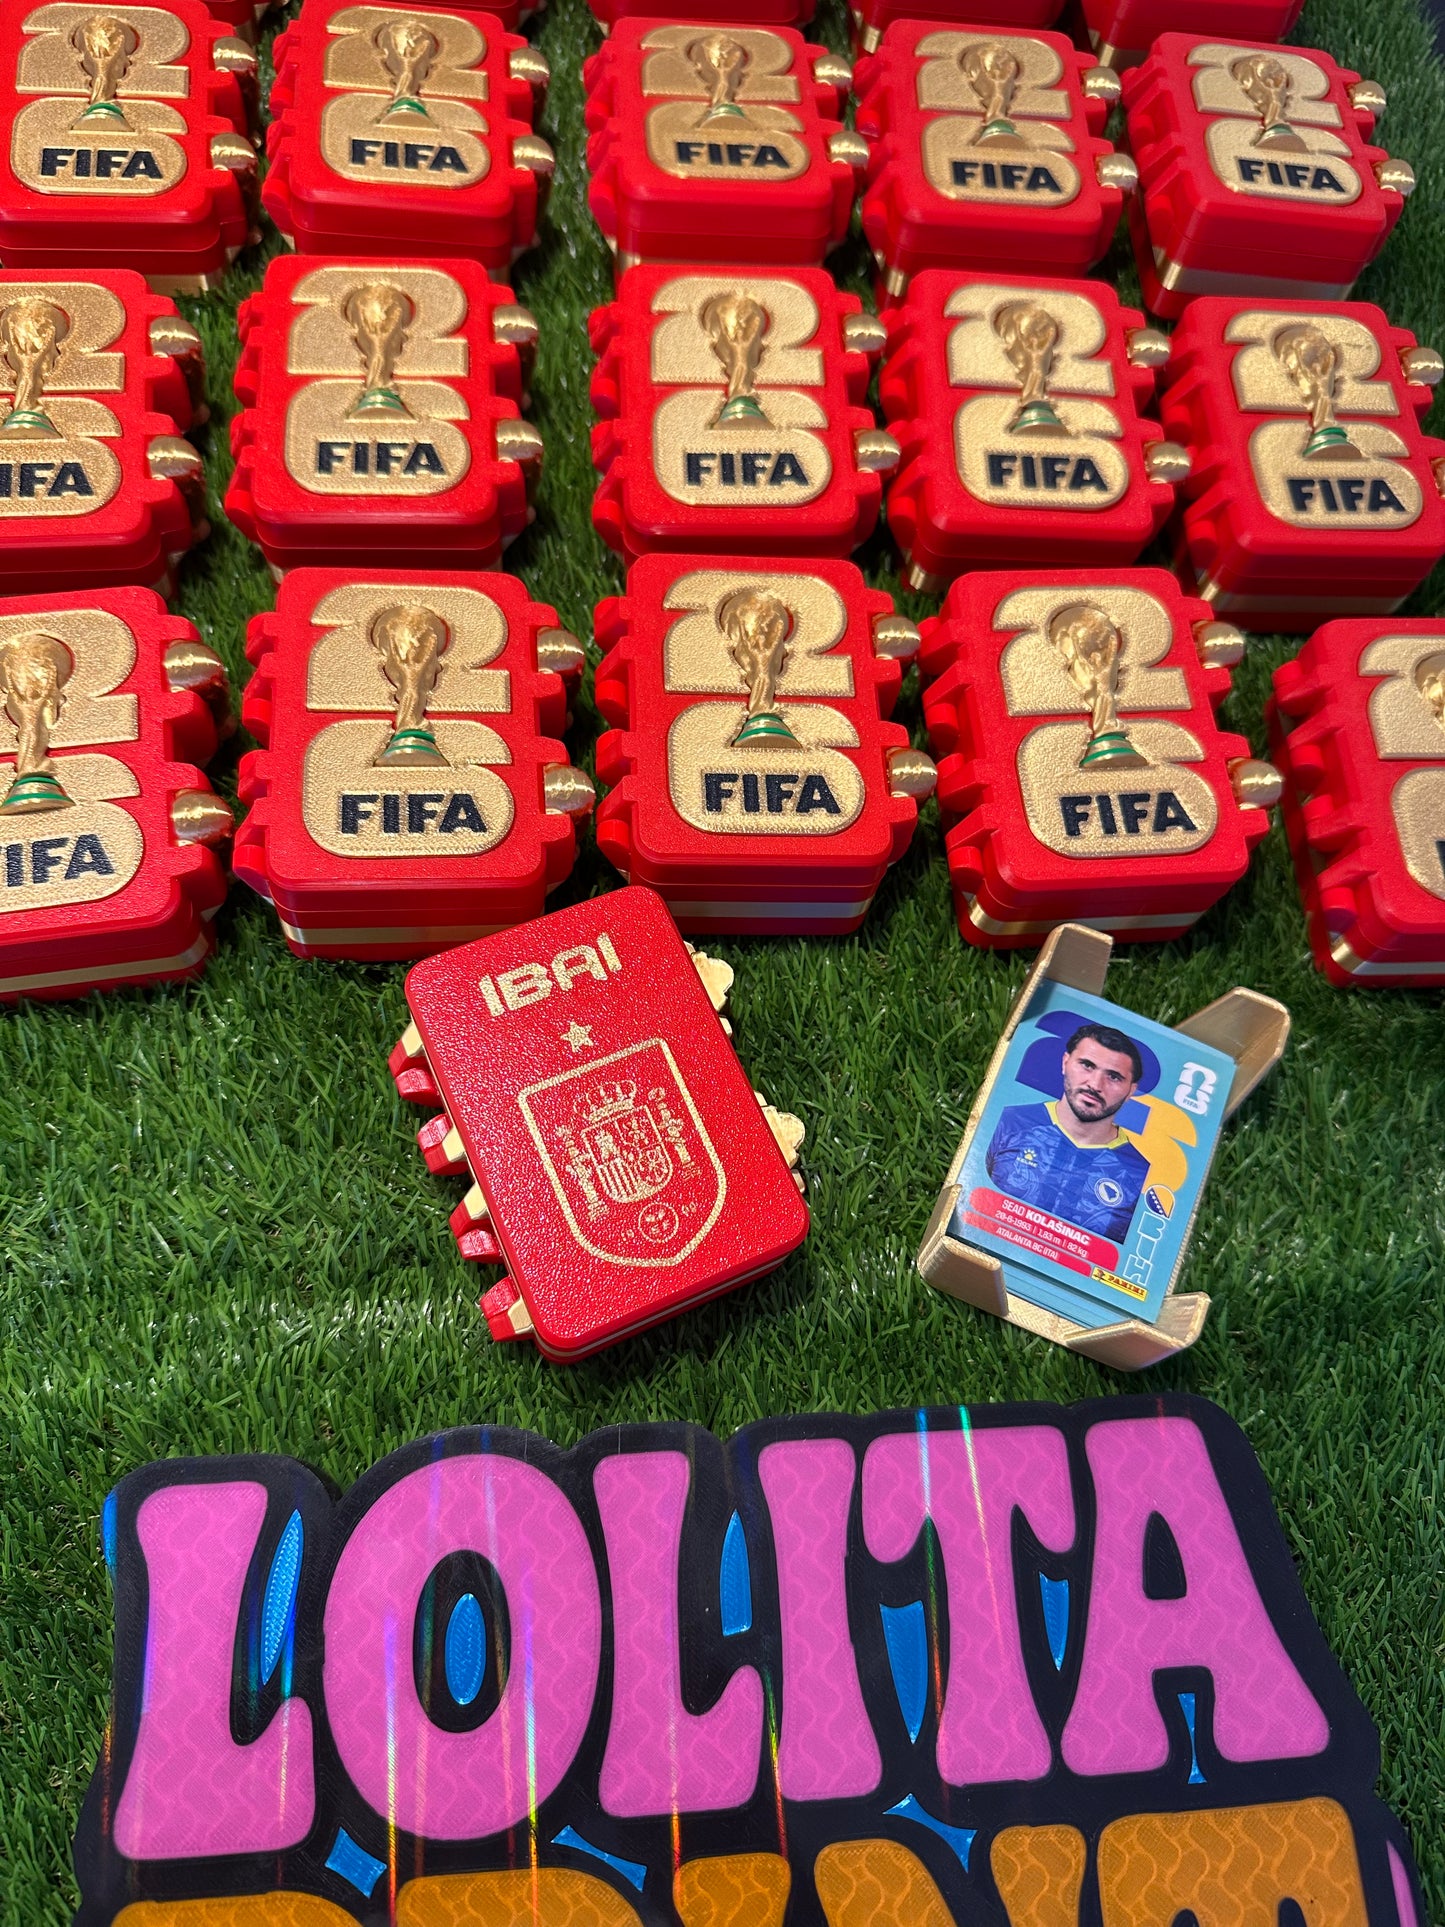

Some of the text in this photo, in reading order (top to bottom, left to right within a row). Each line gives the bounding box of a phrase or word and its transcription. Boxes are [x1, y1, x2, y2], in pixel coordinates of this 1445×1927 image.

[42, 148, 161, 178] FIFA
[351, 139, 467, 173] FIFA
[677, 141, 789, 168] FIFA
[952, 161, 1062, 193] FIFA
[1239, 158, 1345, 193] FIFA
[316, 441, 446, 477] FIFA
[685, 452, 808, 487] FIFA
[988, 454, 1108, 492] FIFA
[0, 462, 94, 498] IFA
[1286, 478, 1406, 513] FIFA
[705, 773, 840, 815] FIFA
[340, 793, 487, 835] FIFA
[1059, 791, 1197, 837] FIFA
[0, 833, 115, 888] IFA
[478, 932, 624, 1018] IBAI
[1000, 1198, 1092, 1246] SEAD KOLAŠINAC
[995, 1225, 1032, 1248] ATALANTA
[1041, 1246, 1059, 1260] (ITA)
[1051, 1236, 1061, 1245] m
[1066, 1241, 1078, 1252] 82
[1075, 1246, 1088, 1258] kg
[1106, 1274, 1145, 1295] PANINI
[113, 1415, 1330, 1861] LOLITA
